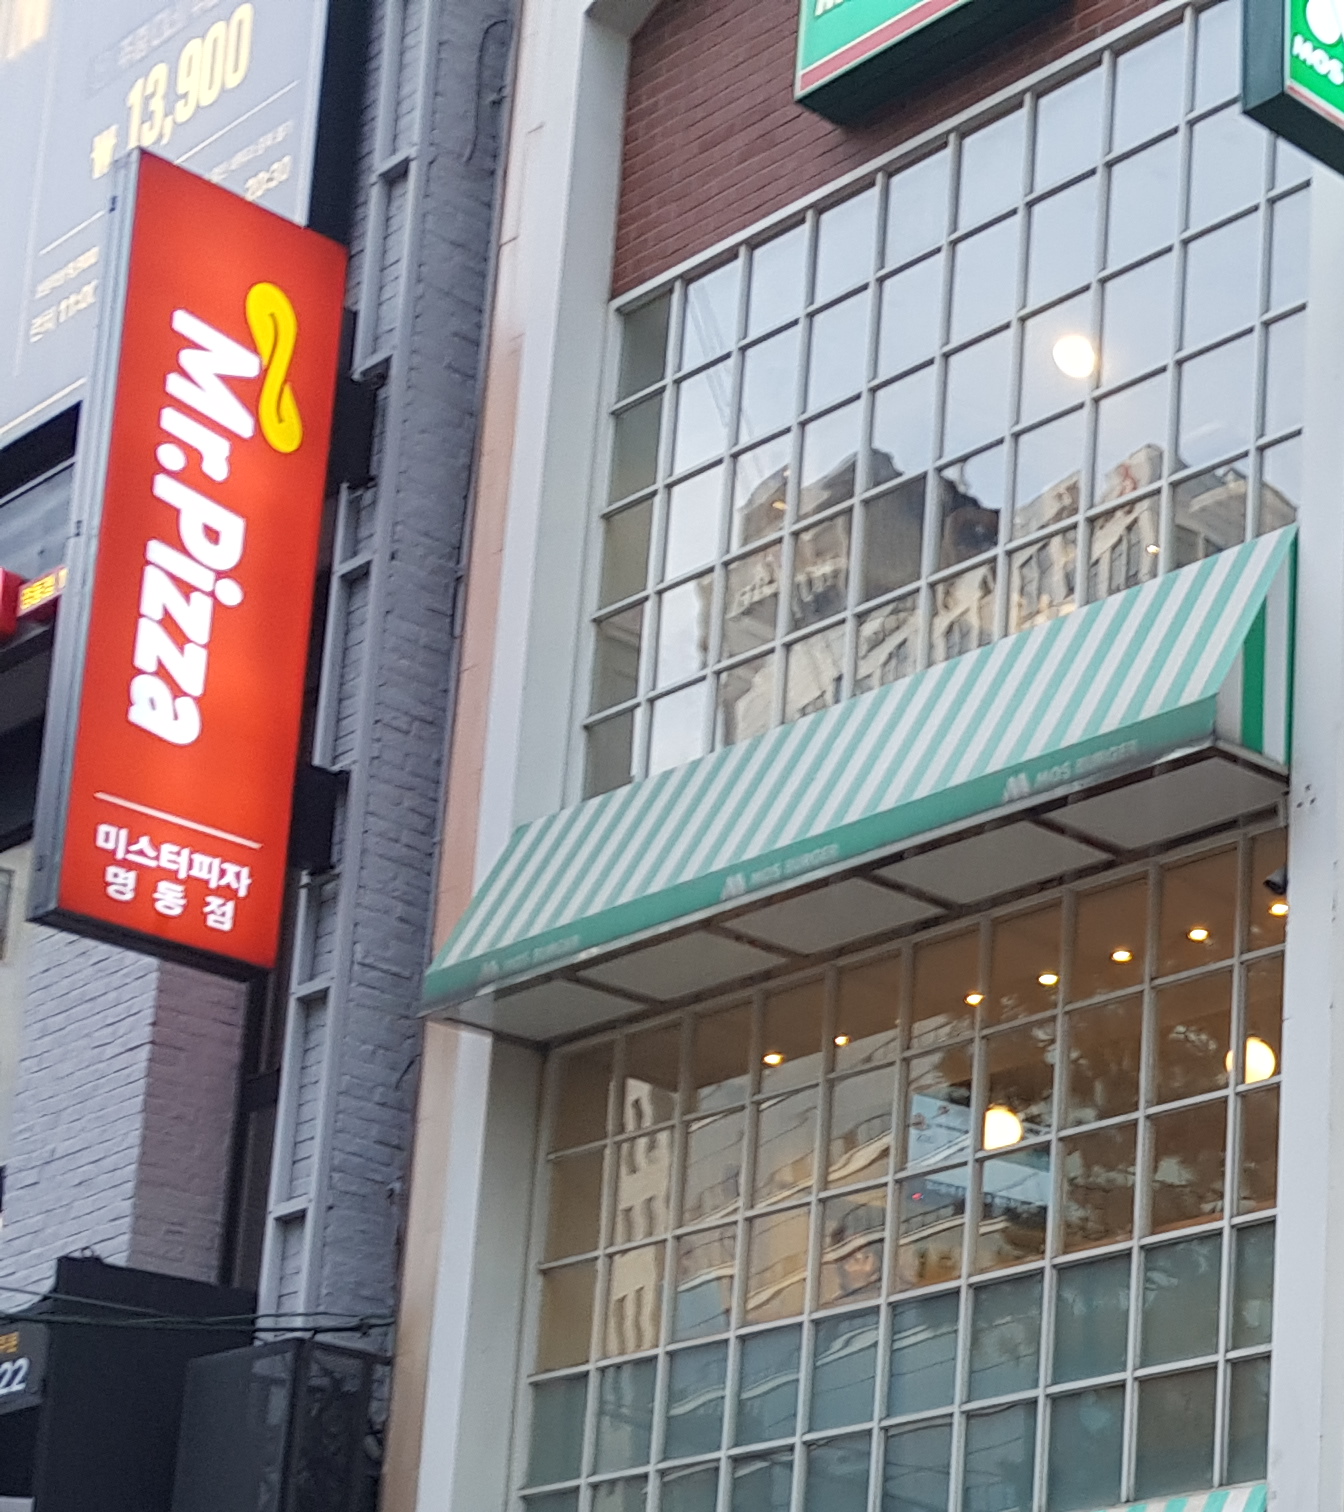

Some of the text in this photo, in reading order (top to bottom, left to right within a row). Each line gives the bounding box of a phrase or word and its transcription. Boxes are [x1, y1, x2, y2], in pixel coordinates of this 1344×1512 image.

[1291, 34, 1344, 88] MOS
[127, 308, 261, 746] Mr.Pizza
[96, 823, 252, 897] 미스터피자
[104, 865, 236, 932] 명동점
